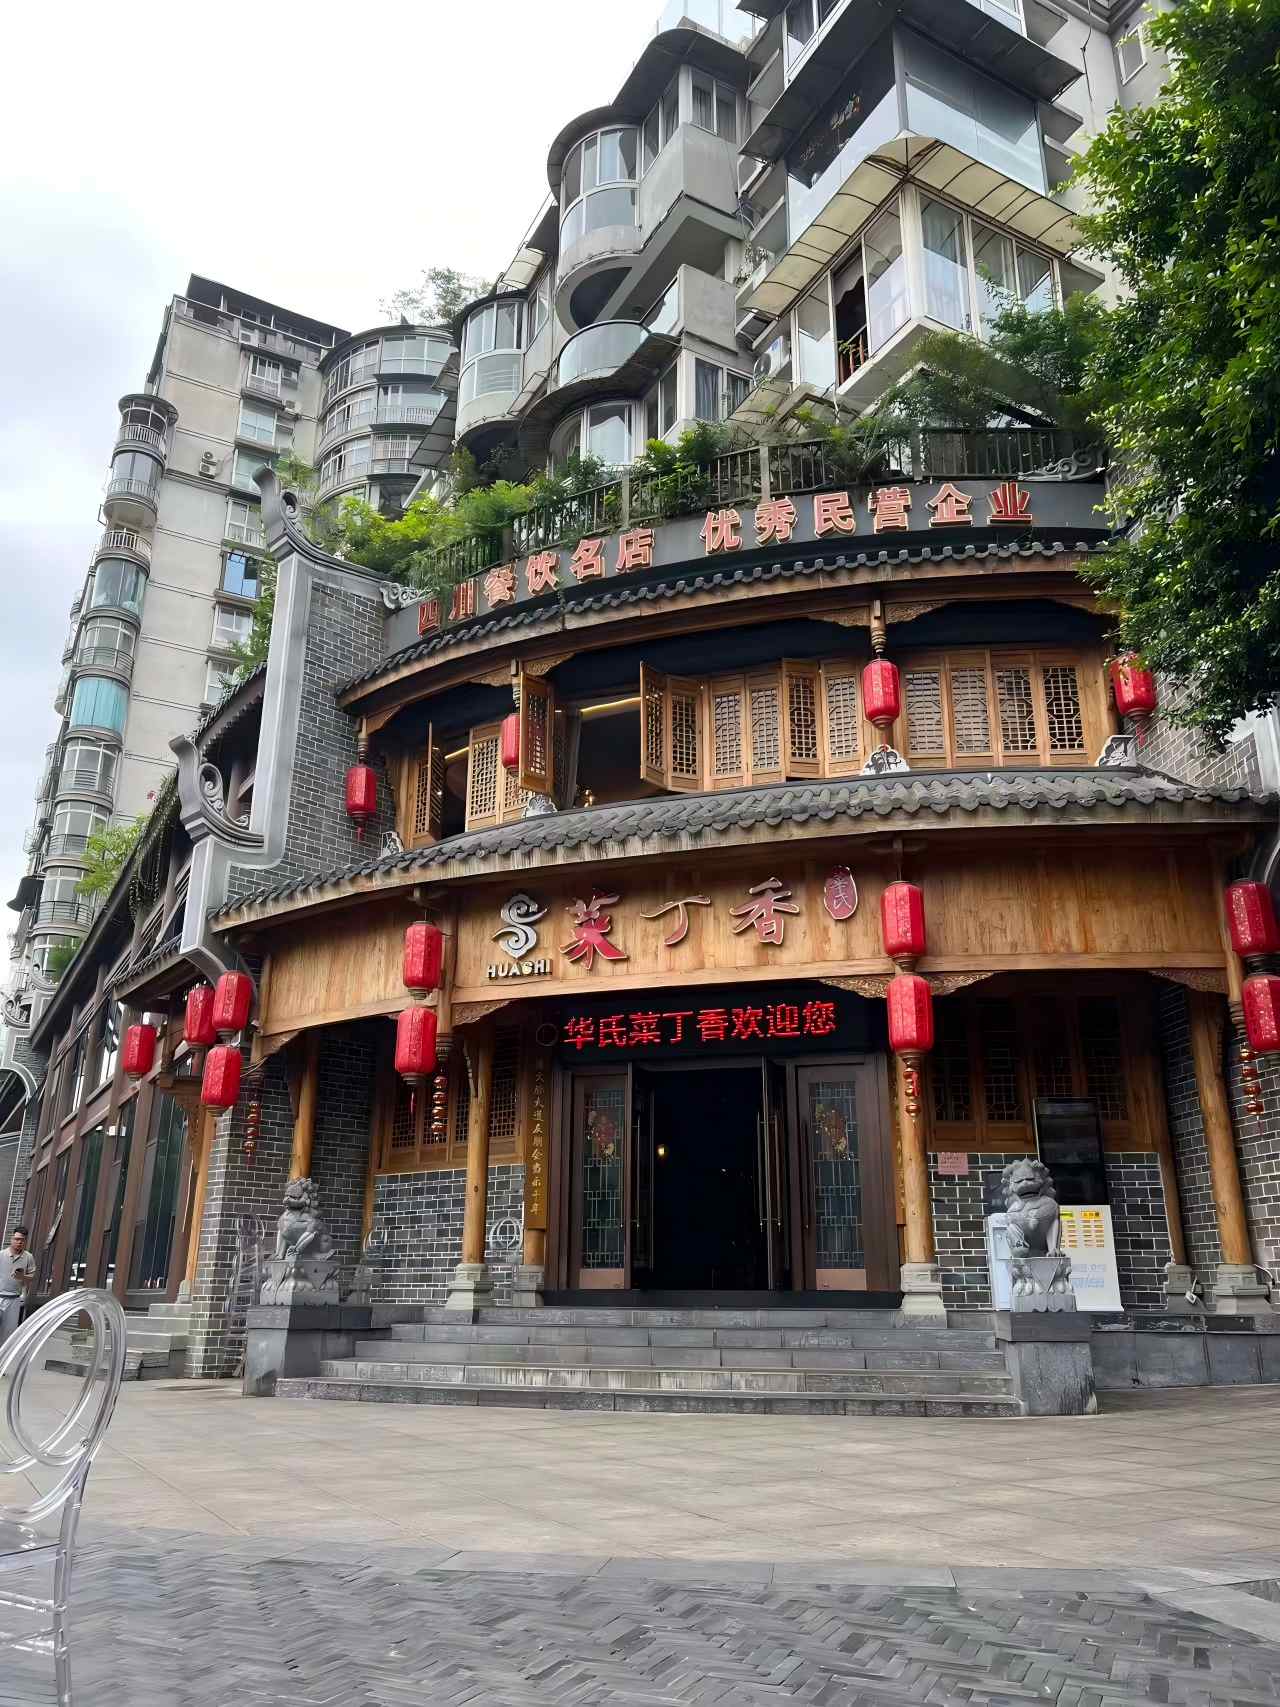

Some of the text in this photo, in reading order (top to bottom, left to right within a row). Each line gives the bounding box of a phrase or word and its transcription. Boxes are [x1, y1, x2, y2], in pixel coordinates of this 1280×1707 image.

[416, 482, 1034, 638] 四川餐饮名店 优秀民营企业
[560, 877, 799, 969] 菜丁香
[486, 959, 553, 979] HUASHI
[564, 1001, 838, 1050] 华氏菜丁香欢迎您
